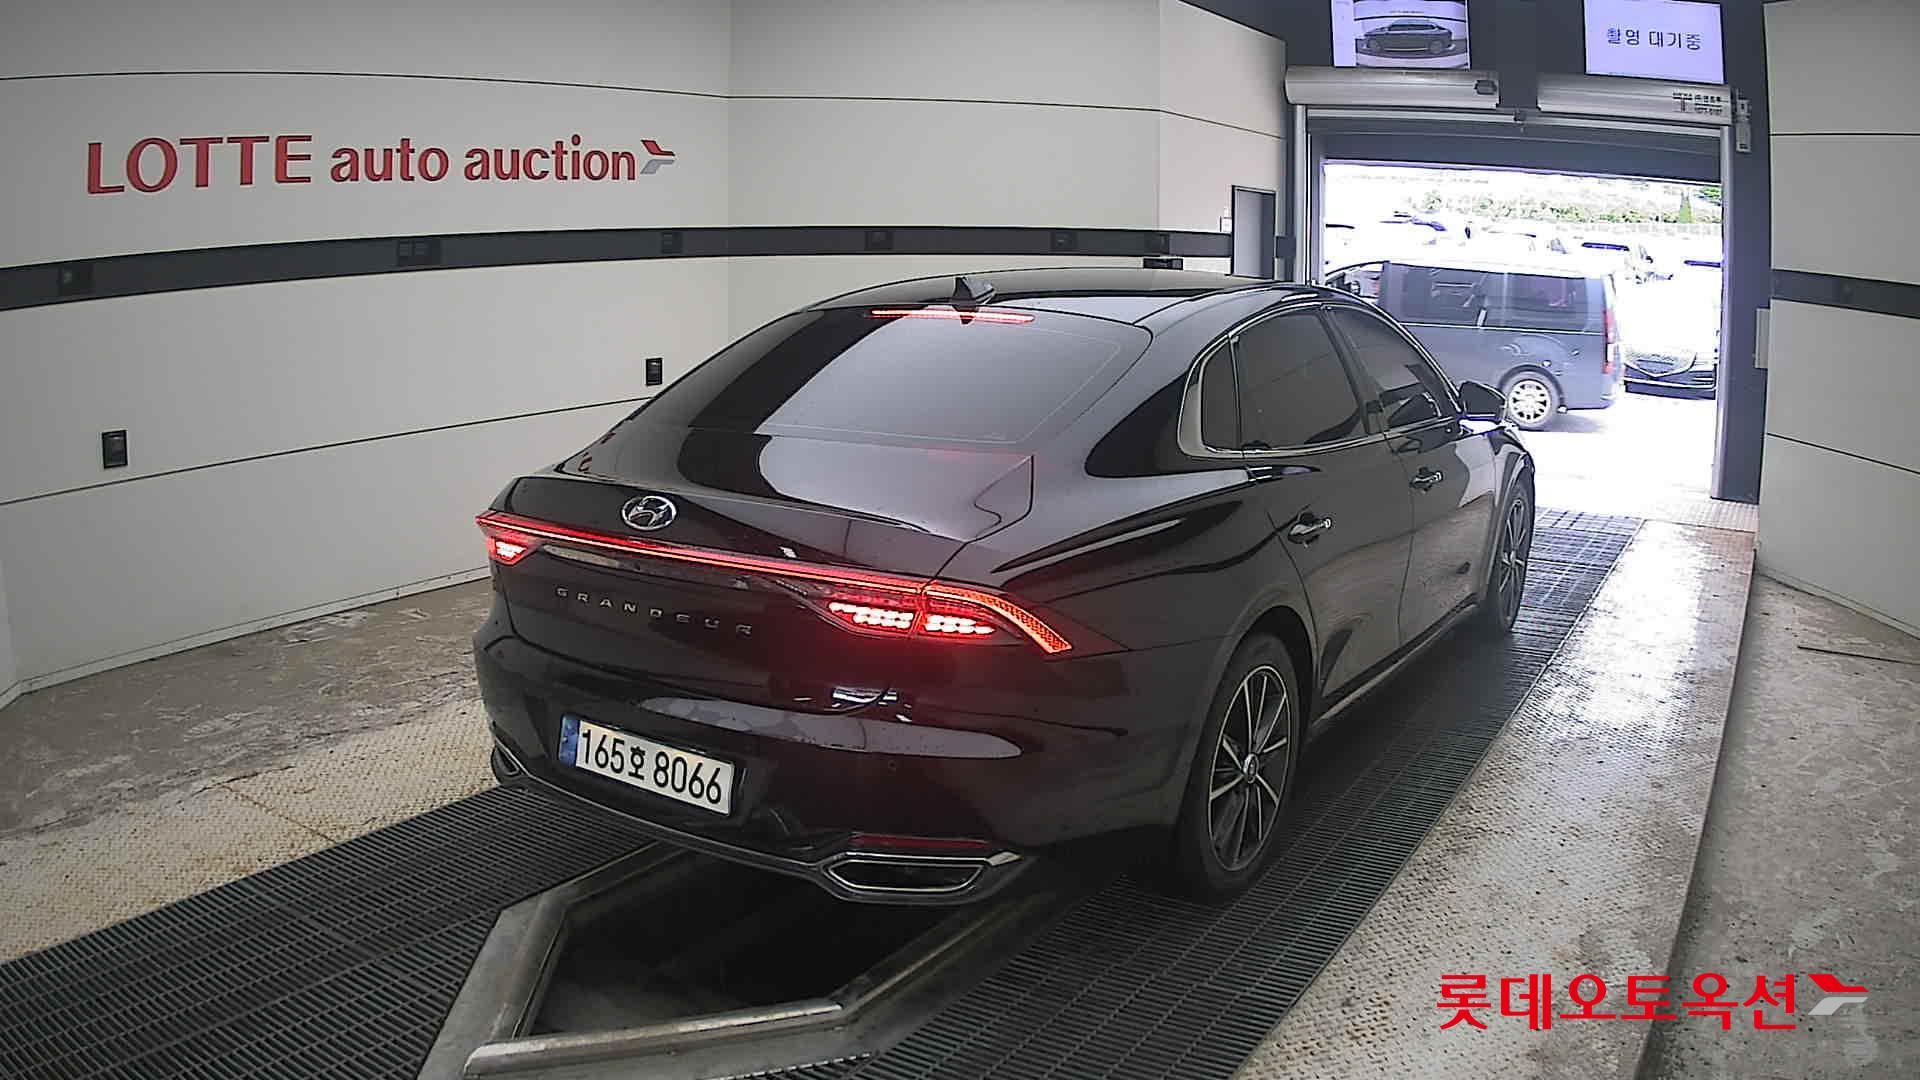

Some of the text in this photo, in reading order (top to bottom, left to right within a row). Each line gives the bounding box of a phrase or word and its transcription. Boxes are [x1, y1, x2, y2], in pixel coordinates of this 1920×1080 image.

[1649, 31, 1701, 51] 대기중
[87, 134, 636, 194] LOTTE auto auction
[556, 587, 752, 635] GRANDEUR
[582, 729, 722, 804] 165호 8066
